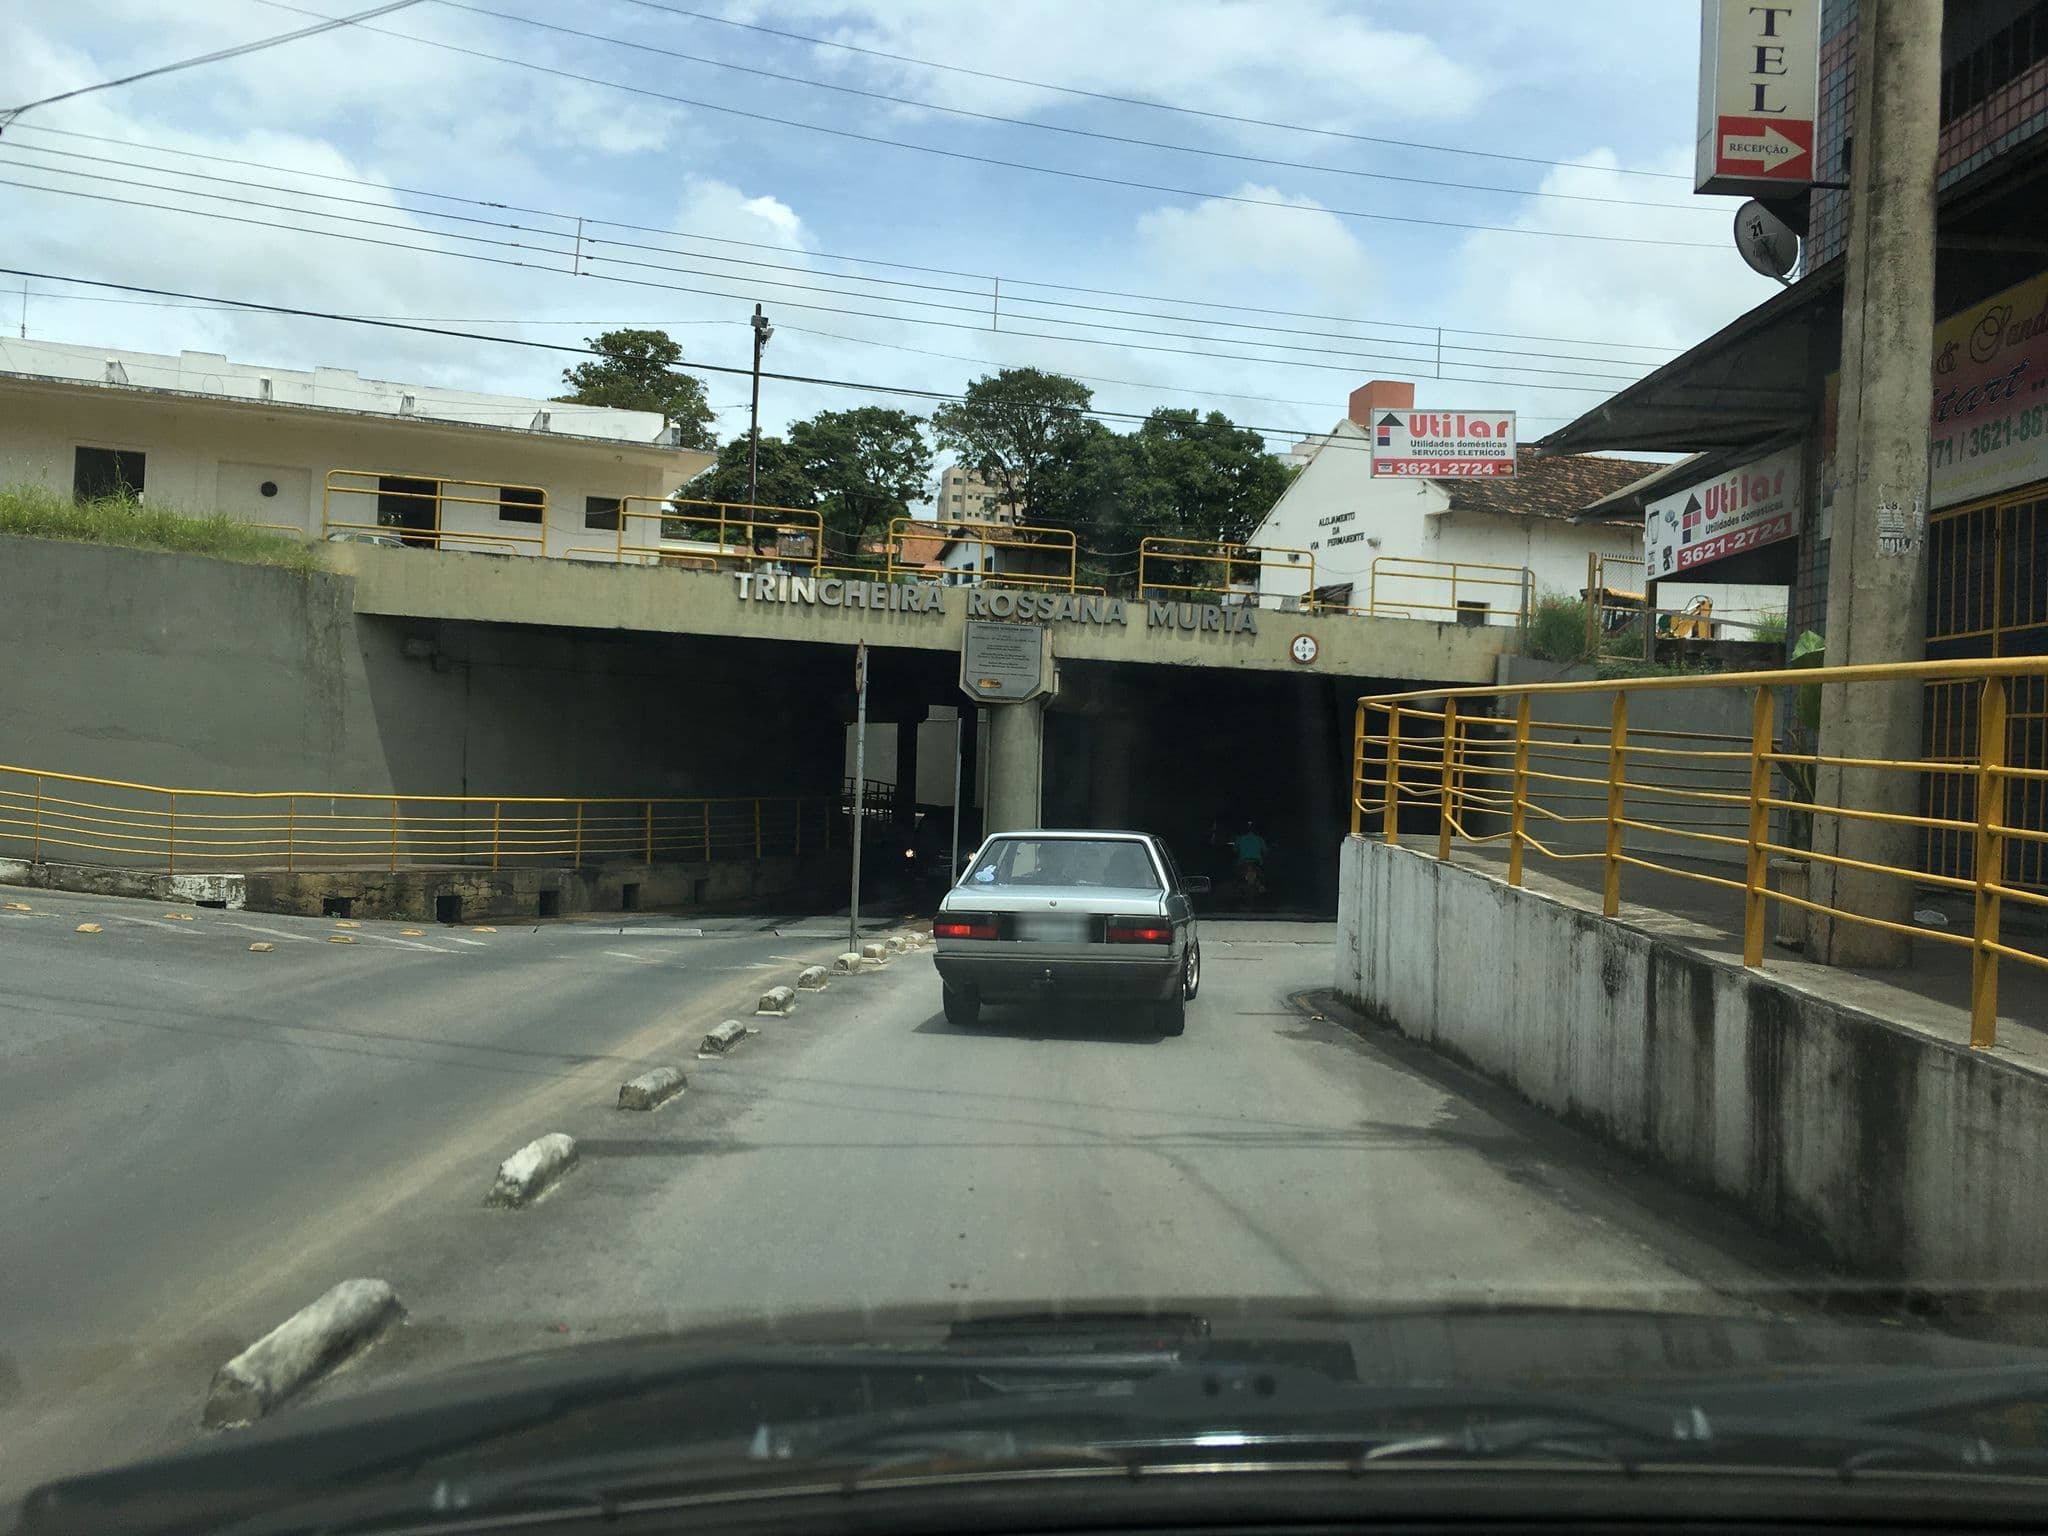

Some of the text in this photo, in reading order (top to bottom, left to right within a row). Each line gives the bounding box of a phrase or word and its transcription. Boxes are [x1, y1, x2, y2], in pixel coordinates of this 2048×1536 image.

[1749, 6, 1792, 114] TEL
[1729, 141, 1789, 156] RECEPÇÃO
[1409, 413, 1509, 439] Utilar
[1410, 440, 1508, 449] Utilidades domésticas
[1411, 449, 1456, 457] SERVIÇOS
[1397, 462, 1495, 476] 3621-2724
[1705, 469, 1786, 521] Utilar
[1705, 515, 1741, 535] Utilidades
[1681, 517, 1786, 566] 3621-2724
[735, 571, 1258, 635] TRINCHEIRA ROSSANA MURTA
